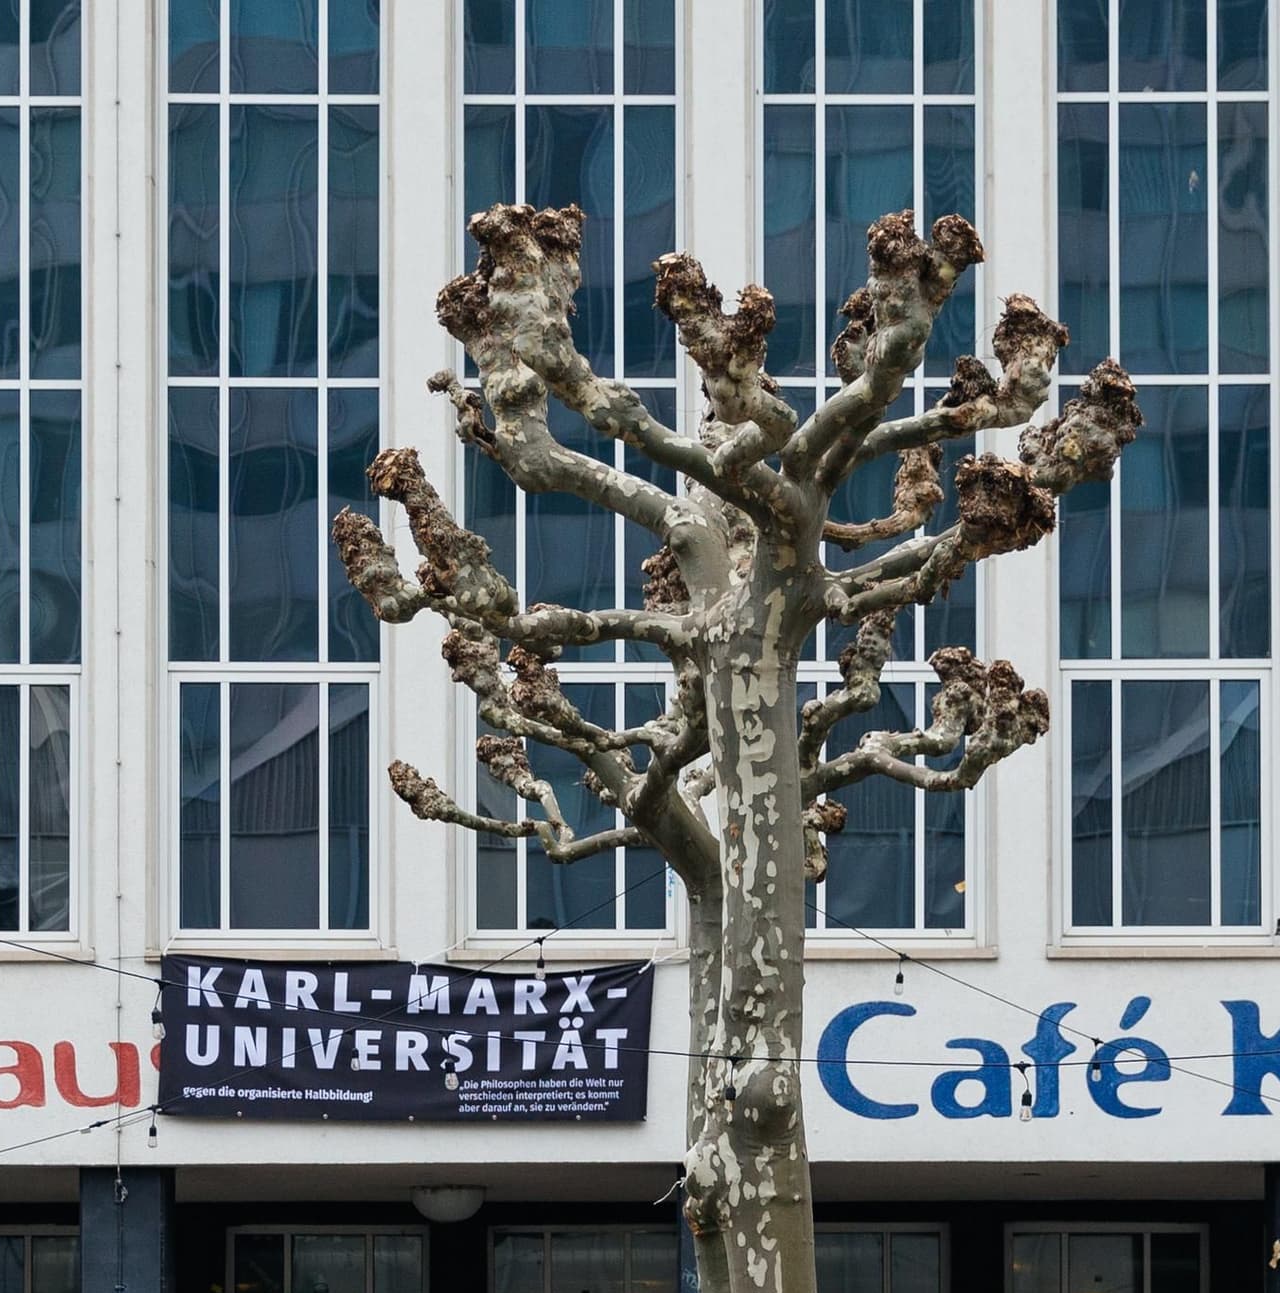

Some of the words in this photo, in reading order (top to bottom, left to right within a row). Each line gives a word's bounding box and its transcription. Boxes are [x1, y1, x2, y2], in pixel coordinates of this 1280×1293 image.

[186, 966, 629, 1016] KARL-MARX-
[185, 1017, 629, 1073] UNIVERSITÄT
[820, 996, 1171, 1120] Café
[183, 1086, 216, 1098] gegen
[218, 1085, 236, 1097] die
[237, 1087, 303, 1101] organisierte
[304, 1089, 373, 1104] Halbbildung!
[480, 1079, 537, 1093] Philosophen
[538, 1079, 568, 1090] haben
[569, 1078, 583, 1089] die
[585, 1077, 608, 1088] Welt
[608, 1080, 624, 1088] nur
[458, 1091, 514, 1101] verschieden
[515, 1089, 573, 1102] interpretiert;
[575, 1092, 587, 1100] es
[588, 1089, 620, 1100] kommt
[458, 1103, 480, 1113] aber
[482, 1102, 512, 1113] darauf
[513, 1104, 529, 1114] an,
[529, 1101, 543, 1112] sie
[544, 1104, 556, 1112] zu
